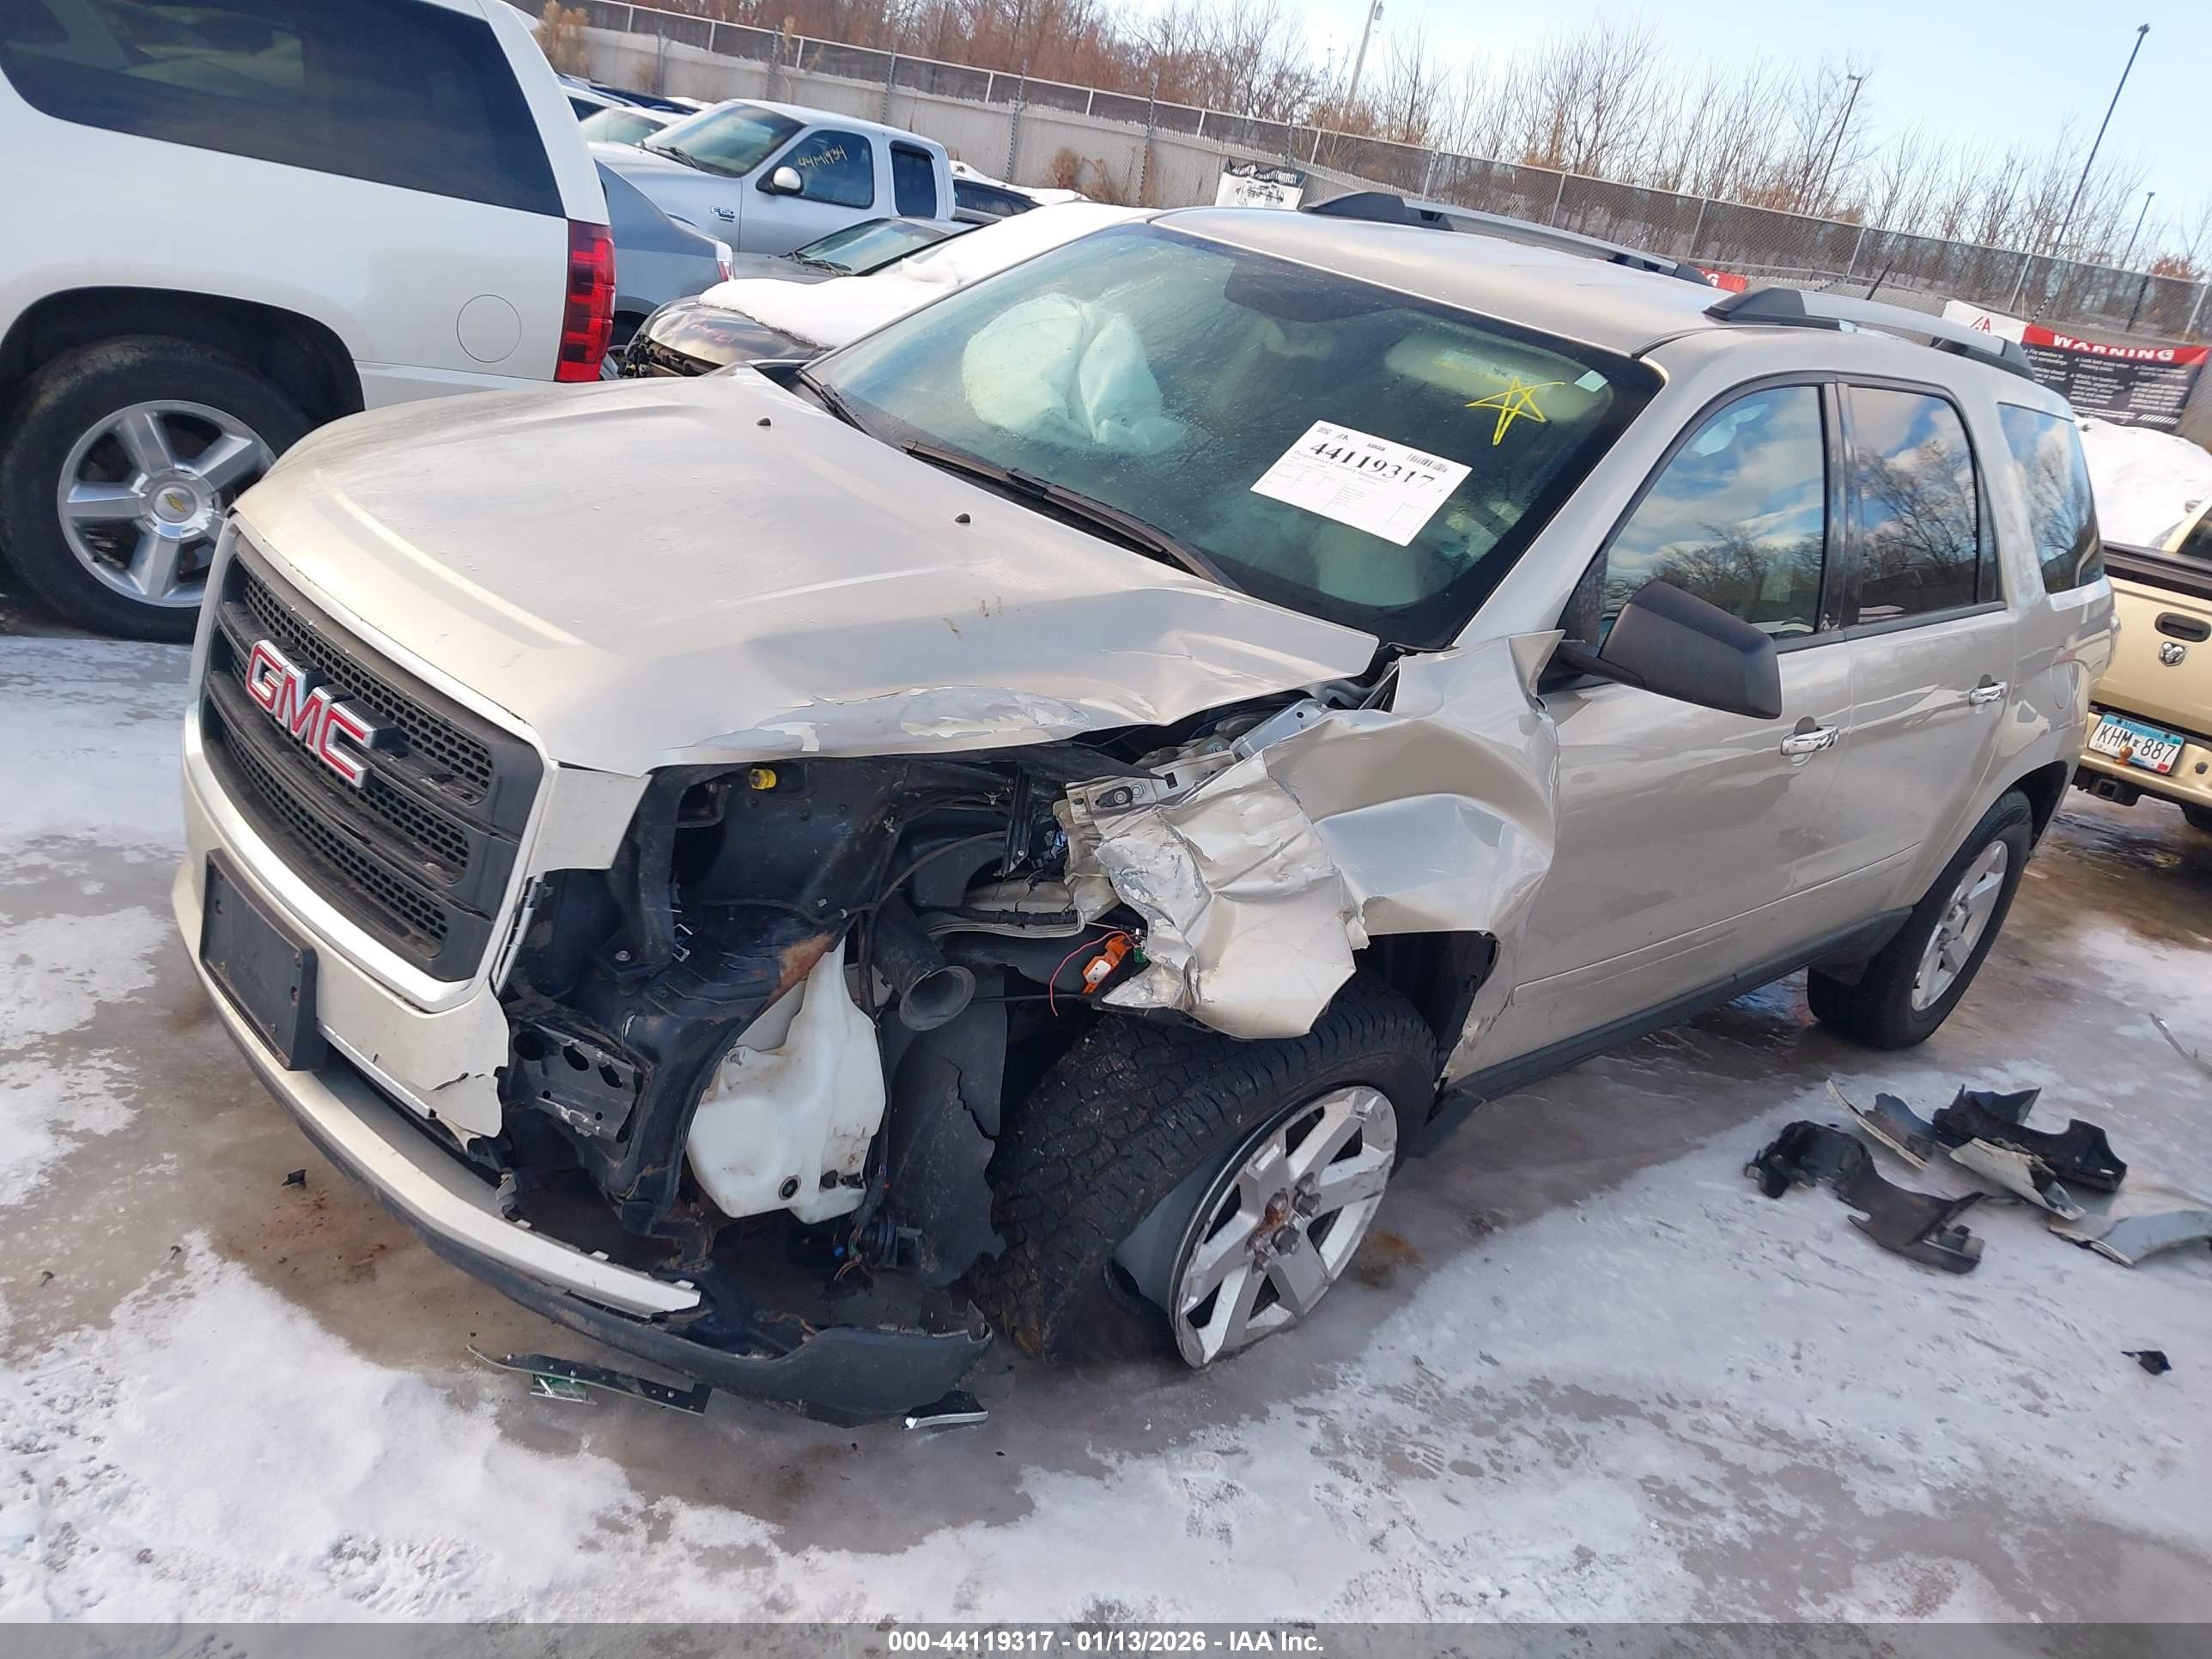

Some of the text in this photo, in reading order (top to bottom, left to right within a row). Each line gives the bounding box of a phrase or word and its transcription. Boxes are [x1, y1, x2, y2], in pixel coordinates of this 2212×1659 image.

[2053, 334, 2175, 362] WARNING
[1310, 442, 1436, 489] 44119317
[246, 639, 377, 788] GMC
[2097, 724, 2177, 763] KHM 887
